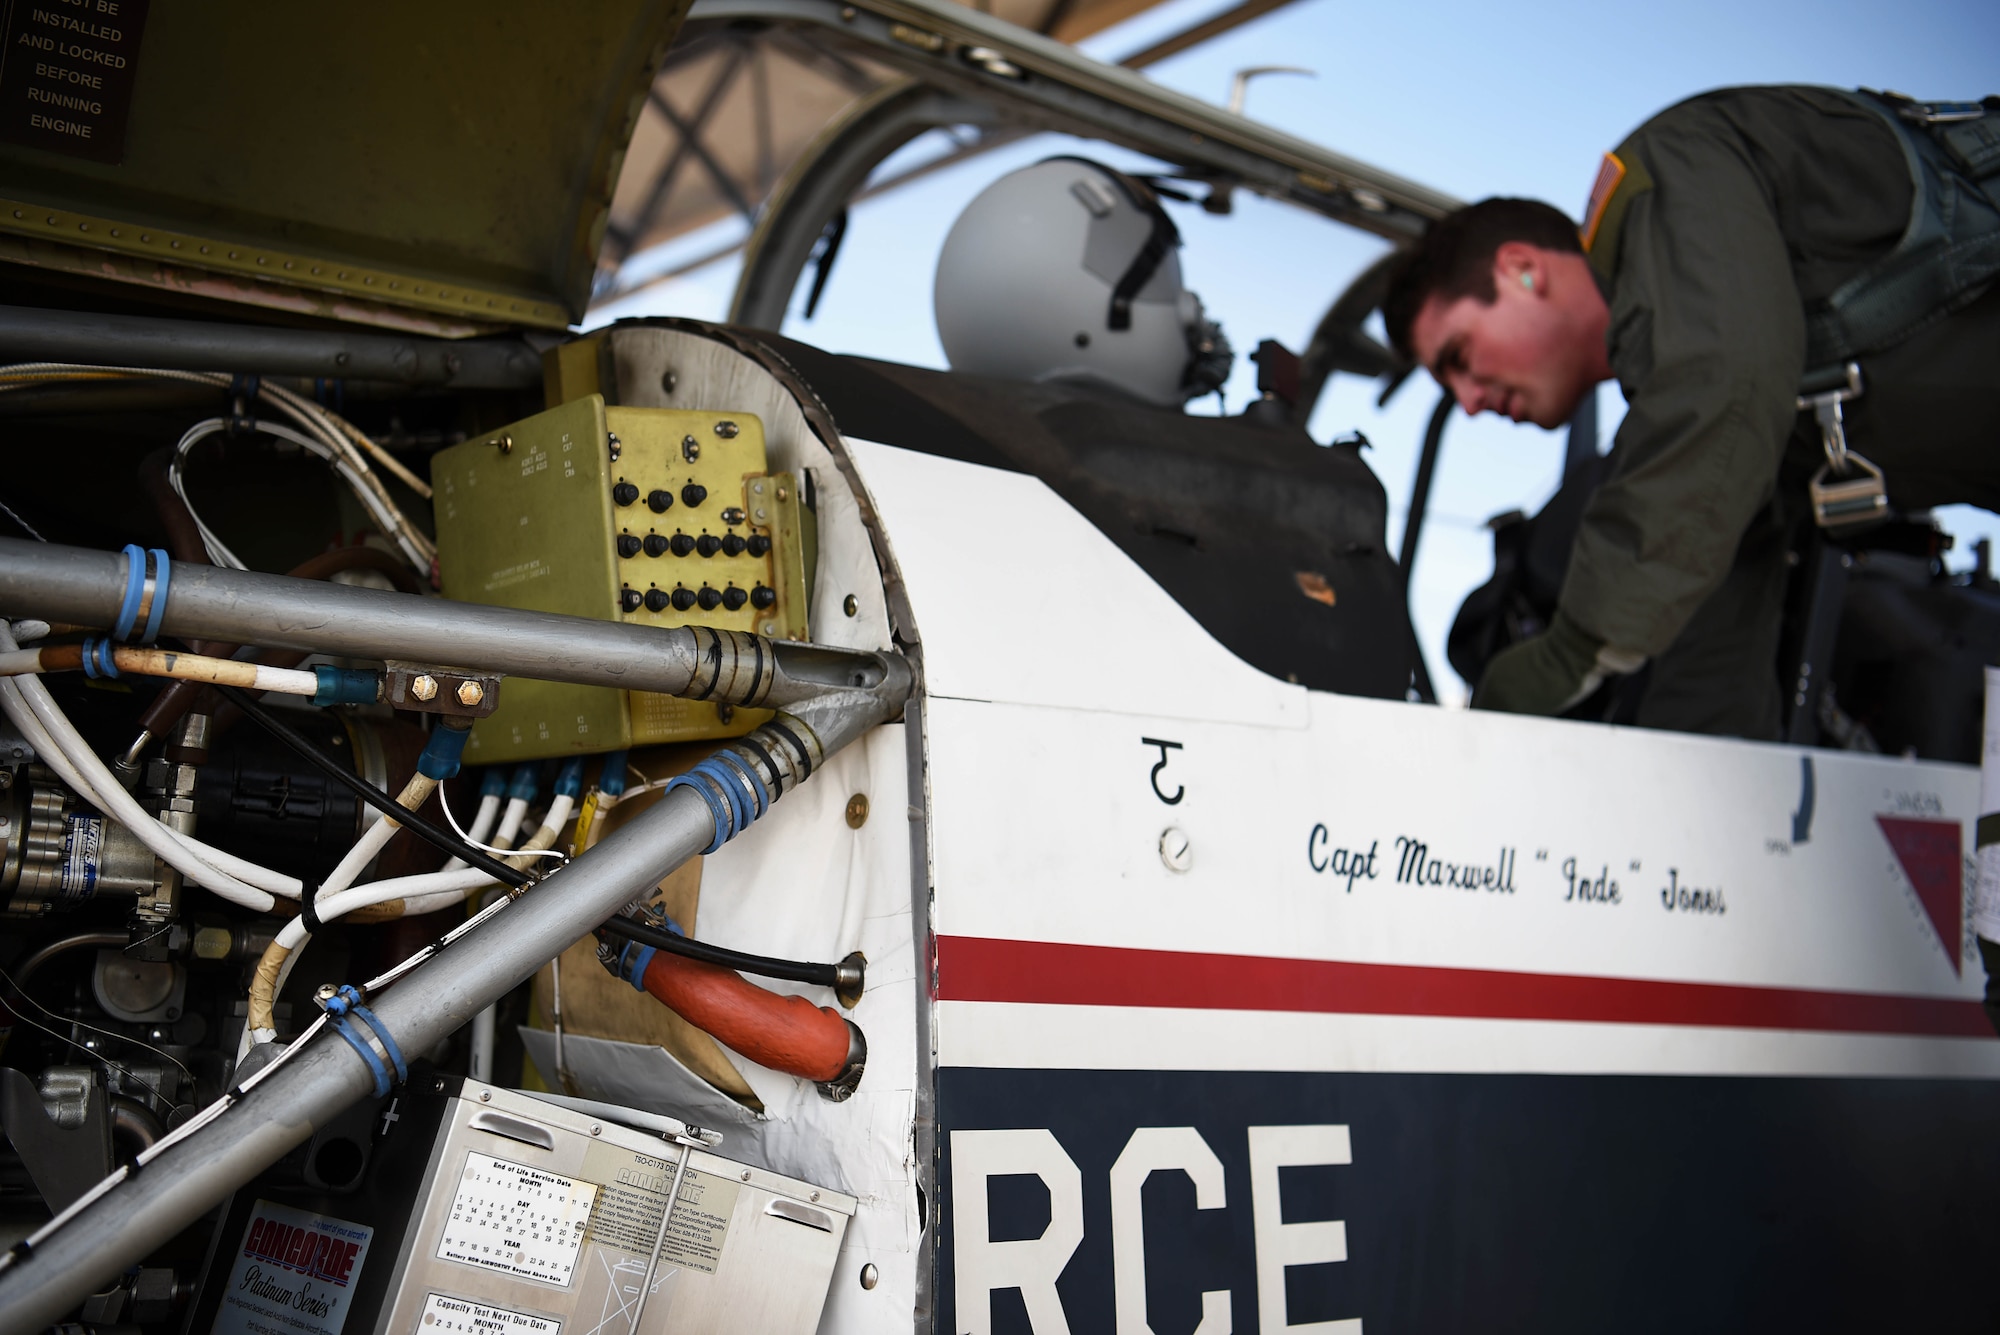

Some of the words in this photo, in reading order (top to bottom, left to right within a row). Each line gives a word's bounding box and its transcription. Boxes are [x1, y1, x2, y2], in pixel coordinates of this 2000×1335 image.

[96, 0, 119, 16] BE
[32, 8, 122, 42] INSTALLED
[18, 32, 55, 51] AND
[58, 42, 126, 69] LOCKED
[35, 62, 103, 89] BEFORE
[27, 86, 102, 115] RUNNING
[30, 114, 92, 138] ENGINE
[85, 818, 100, 866] VICKERS
[1306, 824, 1378, 893] Capt
[1395, 836, 1515, 893] Maxwell
[1662, 870, 1729, 915] Jones
[493, 1162, 506, 1170] End
[516, 1168, 529, 1177] Life
[531, 1172, 555, 1183] Service
[556, 1178, 571, 1188] Date
[634, 1155, 664, 1170] TSO-C173
[665, 1164, 697, 1179] DEVTION
[519, 1177, 542, 1188] MONTH
[616, 1167, 704, 1204] CONCODE
[517, 1200, 530, 1208] DAY
[618, 1189, 638, 1200] approval
[689, 1207, 700, 1216] Type
[701, 1211, 726, 1223] Certificated
[625, 1199, 638, 1207] latest
[639, 1202, 662, 1213] Concorde
[679, 1213, 706, 1226] Corporation
[243, 1217, 360, 1288] CONCORDE
[503, 1239, 521, 1249] YEAR
[446, 1251, 469, 1261] Battery
[512, 1267, 531, 1276] Beyond
[532, 1271, 548, 1279] Above
[240, 1265, 292, 1305] Platinum
[437, 1298, 471, 1315] Capacity
[473, 1307, 490, 1317] Test
[493, 1311, 511, 1322] Next
[513, 1316, 527, 1326] Due
[529, 1319, 547, 1331] Date
[474, 1318, 504, 1331] MONTH
